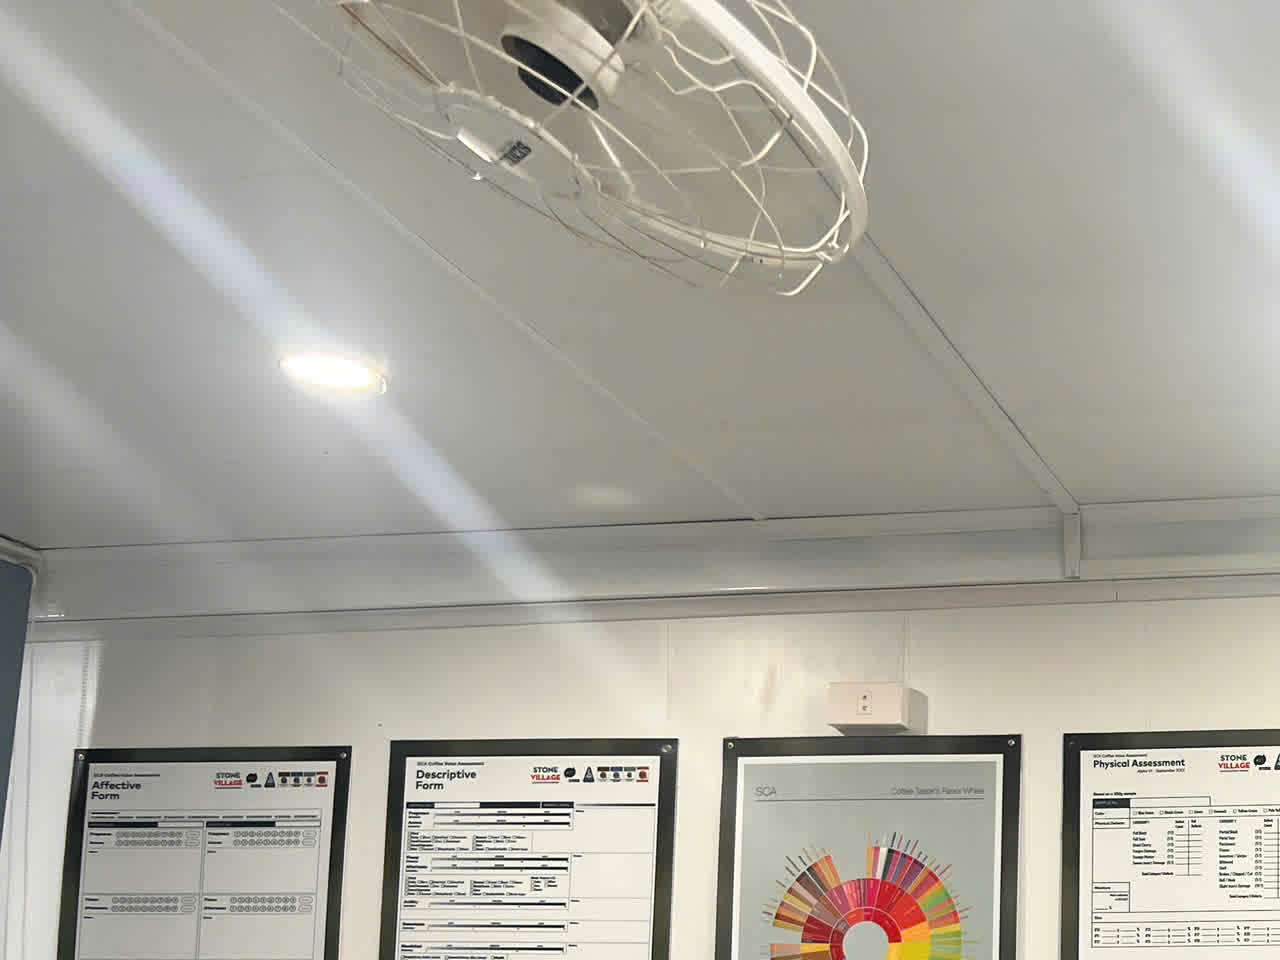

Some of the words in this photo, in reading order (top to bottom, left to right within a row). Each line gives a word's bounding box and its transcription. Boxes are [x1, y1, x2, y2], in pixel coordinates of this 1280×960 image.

[1220, 754, 1247, 762] STONE
[1093, 760, 1130, 770] Physical
[1131, 759, 1186, 767] Assessment
[416, 769, 477, 781] Descriptive
[92, 780, 142, 791] Affective
[416, 780, 444, 790] Form
[91, 791, 120, 800] Form
